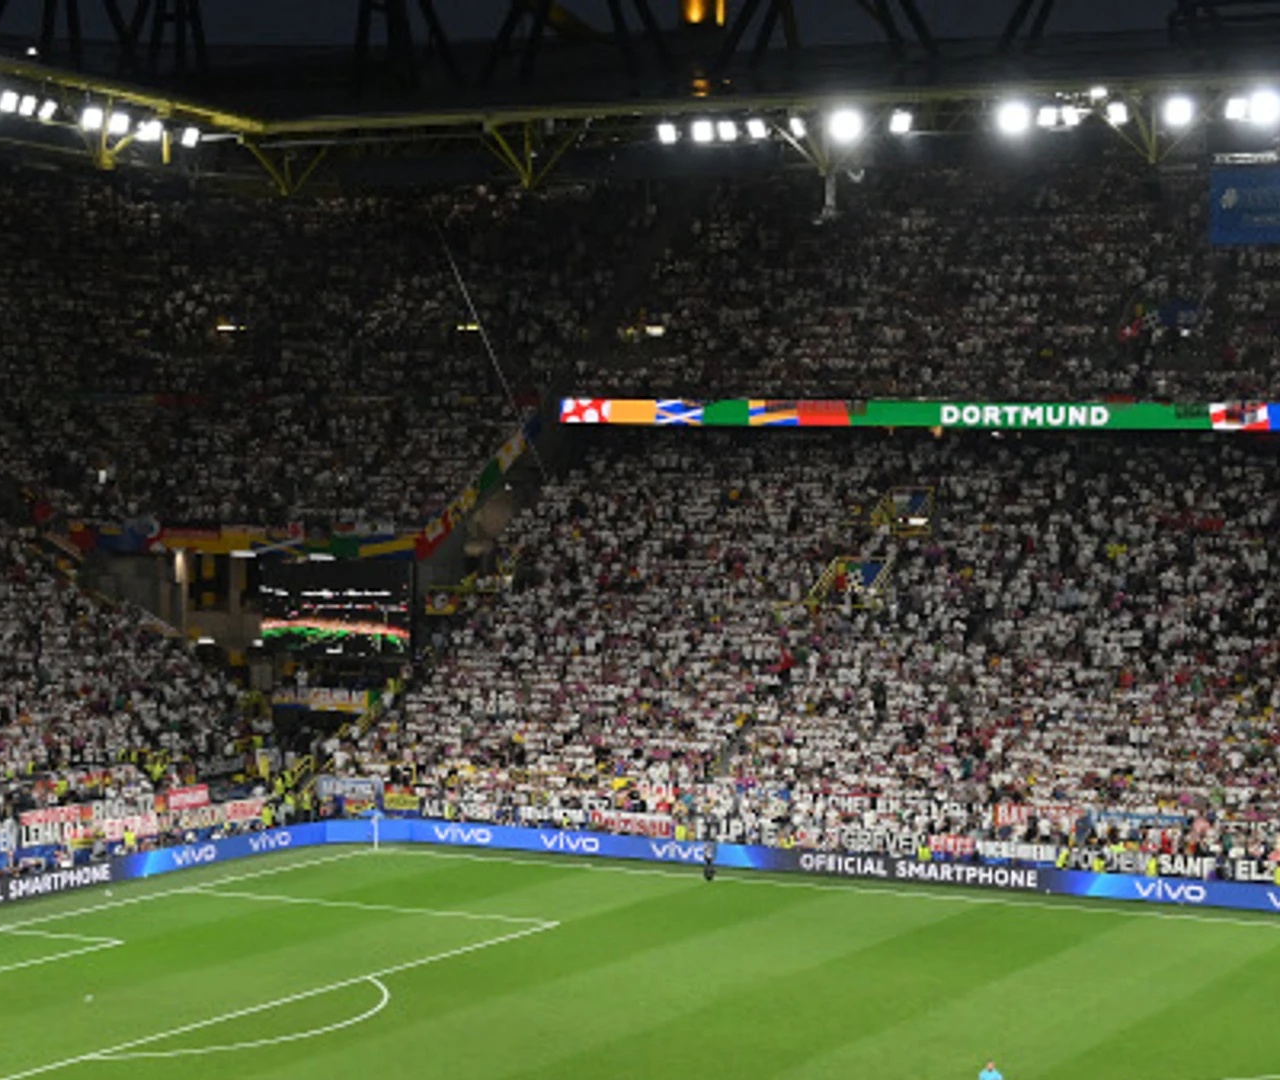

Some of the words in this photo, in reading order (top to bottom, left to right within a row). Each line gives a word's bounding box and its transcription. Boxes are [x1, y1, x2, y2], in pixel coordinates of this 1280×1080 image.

[940, 404, 1111, 428] DORTMUND
[172, 842, 218, 867] vivo
[249, 830, 292, 853] vivo
[433, 824, 493, 844] vivo
[539, 832, 600, 853] vivo
[8, 863, 112, 901] SMARTPHONE
[798, 852, 888, 878] OFFICIAL
[895, 860, 1039, 889] SMARTPHONE
[1135, 879, 1207, 903] vivo
